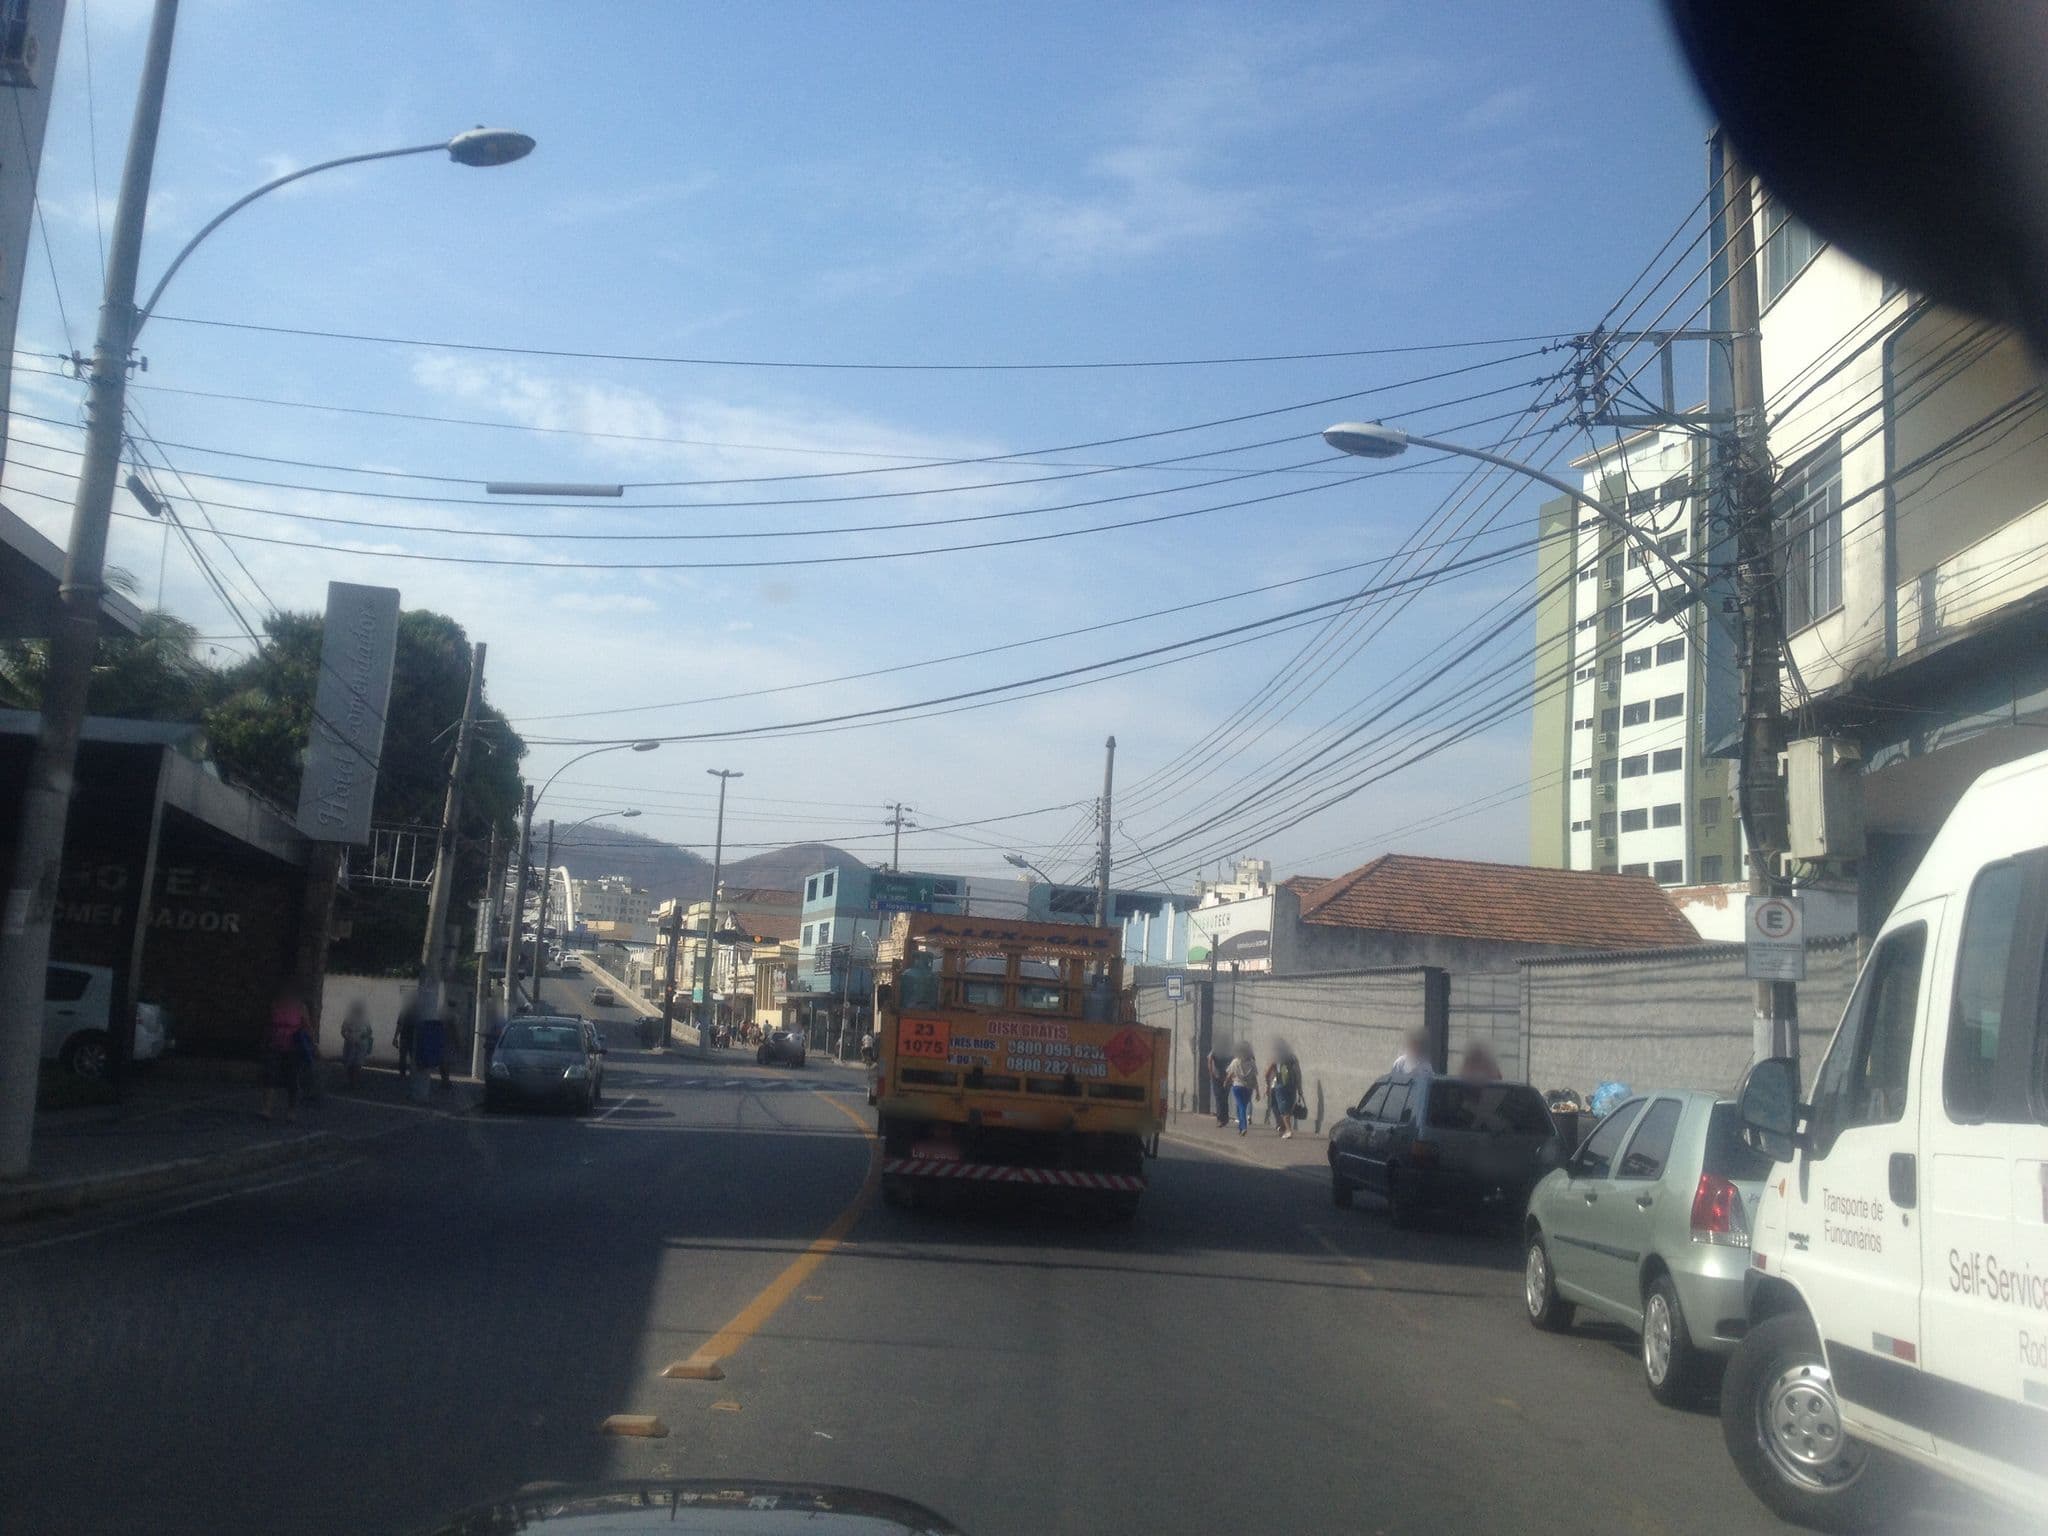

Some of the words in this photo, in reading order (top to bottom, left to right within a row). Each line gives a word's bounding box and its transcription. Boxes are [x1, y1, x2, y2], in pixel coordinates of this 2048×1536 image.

[1767, 910, 1784, 929] E
[914, 1023, 935, 1036] 23
[987, 1020, 1018, 1035] DISK
[903, 1040, 944, 1053] 1075
[1007, 1039, 1042, 1056] 0800
[1006, 1055, 1041, 1072] 0800
[1043, 1058, 1069, 1074] 282
[1822, 1186, 1869, 1222] Transporte
[1870, 1195, 1884, 1222] de
[1823, 1219, 1883, 1254] Funcionários
[1948, 1247, 2048, 1311] Self-Service
